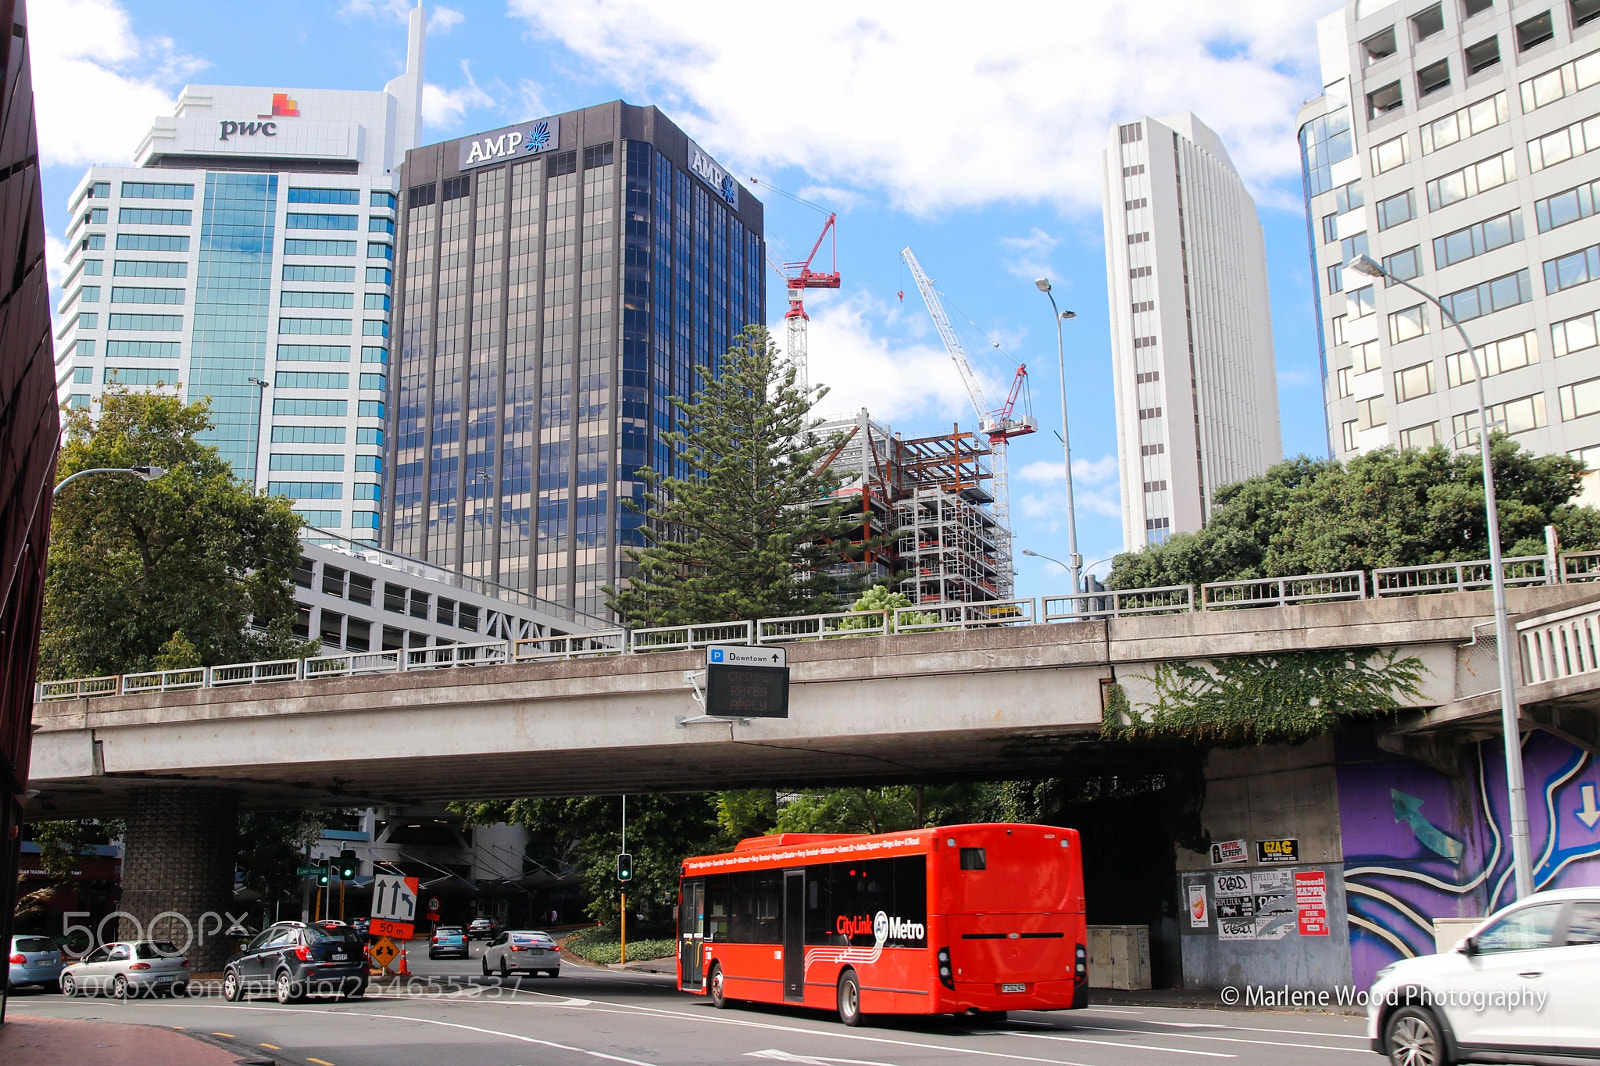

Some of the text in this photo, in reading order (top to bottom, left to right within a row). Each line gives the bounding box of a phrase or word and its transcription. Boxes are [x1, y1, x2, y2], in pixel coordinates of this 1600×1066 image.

[219, 120, 277, 140] pwc
[466, 132, 523, 165] AMP
[691, 150, 722, 190] AMP
[729, 652, 768, 662] Downtown
[728, 671, 770, 683] CASUAL
[730, 686, 767, 697] RATES
[730, 700, 767, 711] APPLY
[1263, 841, 1282, 853] GZA
[1296, 878, 1324, 886] Dweezil
[380, 923, 393, 933] 50
[836, 914, 873, 940] CityLink
[889, 916, 924, 940] Metro
